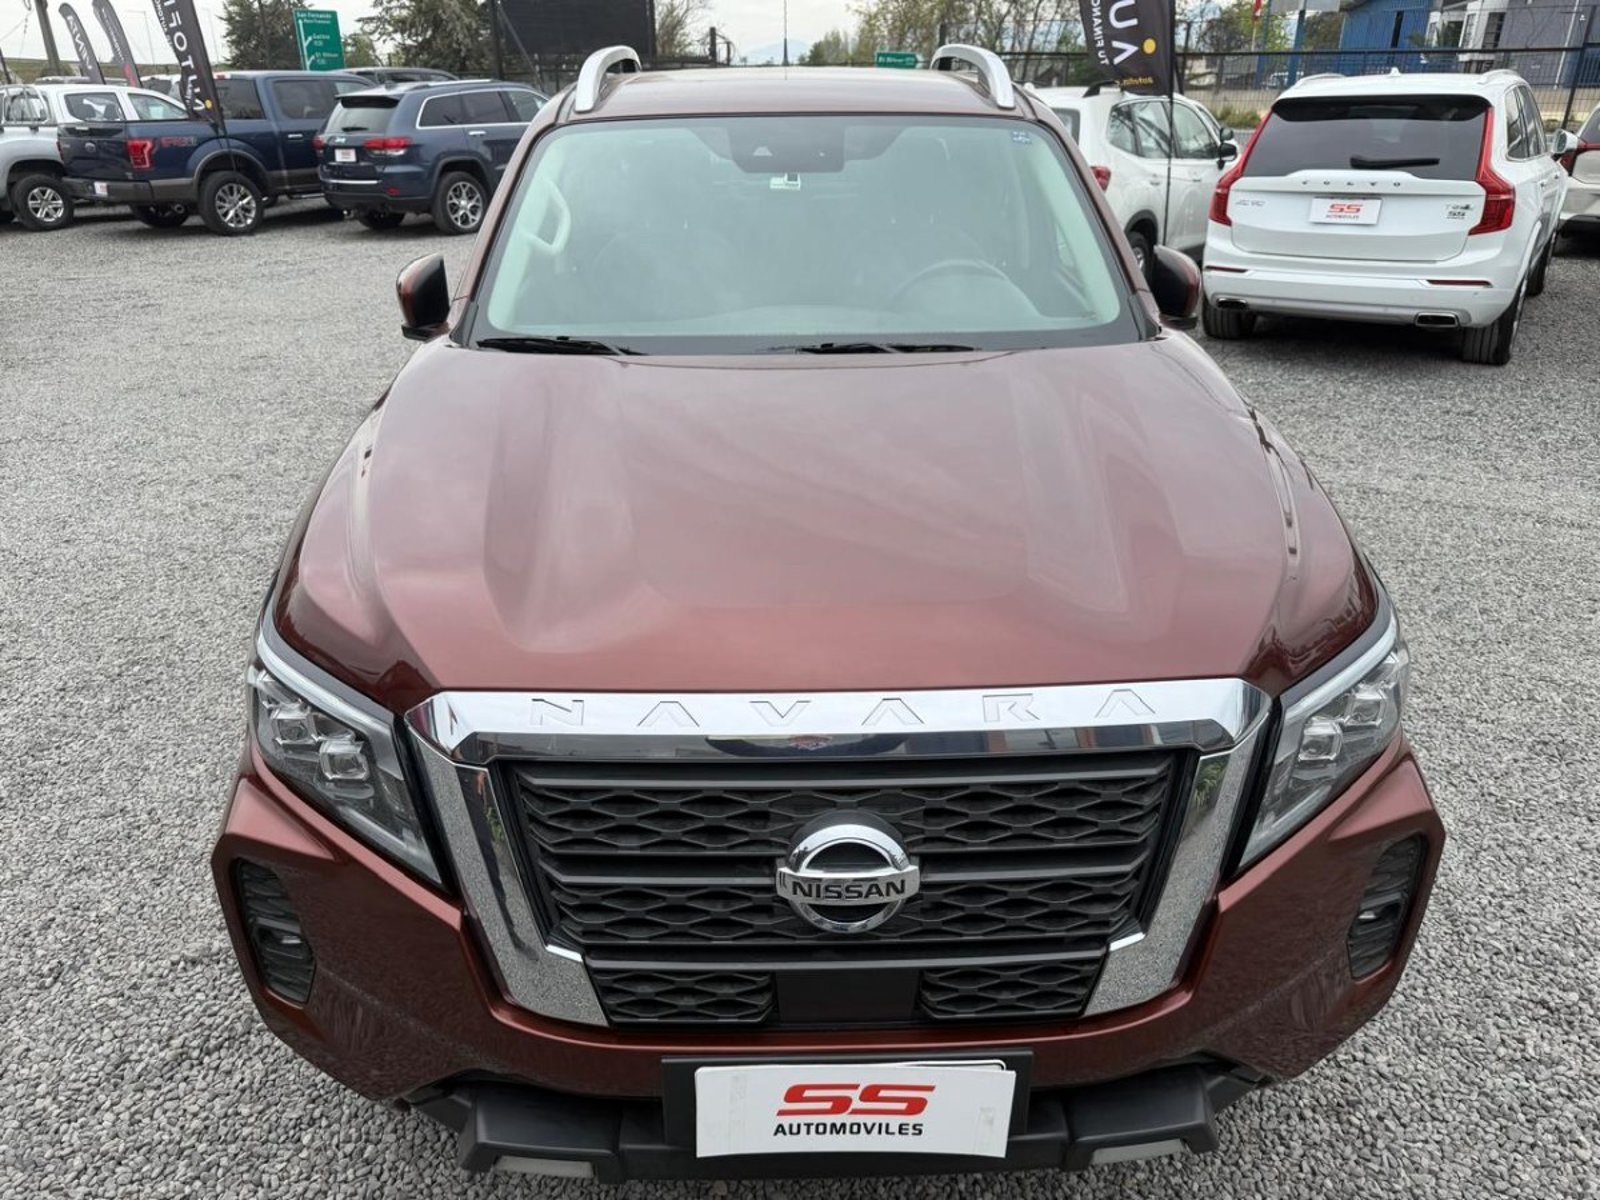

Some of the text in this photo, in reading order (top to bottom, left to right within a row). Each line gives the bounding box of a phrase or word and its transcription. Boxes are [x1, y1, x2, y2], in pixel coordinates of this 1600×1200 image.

[1301, 180, 1401, 188] VOLVO
[1328, 203, 1363, 213] SS
[529, 688, 1156, 727] NAVARA
[791, 879, 906, 899] NISSAN
[776, 1084, 936, 1116] SS
[773, 1122, 924, 1137] AUTOMOVILES
